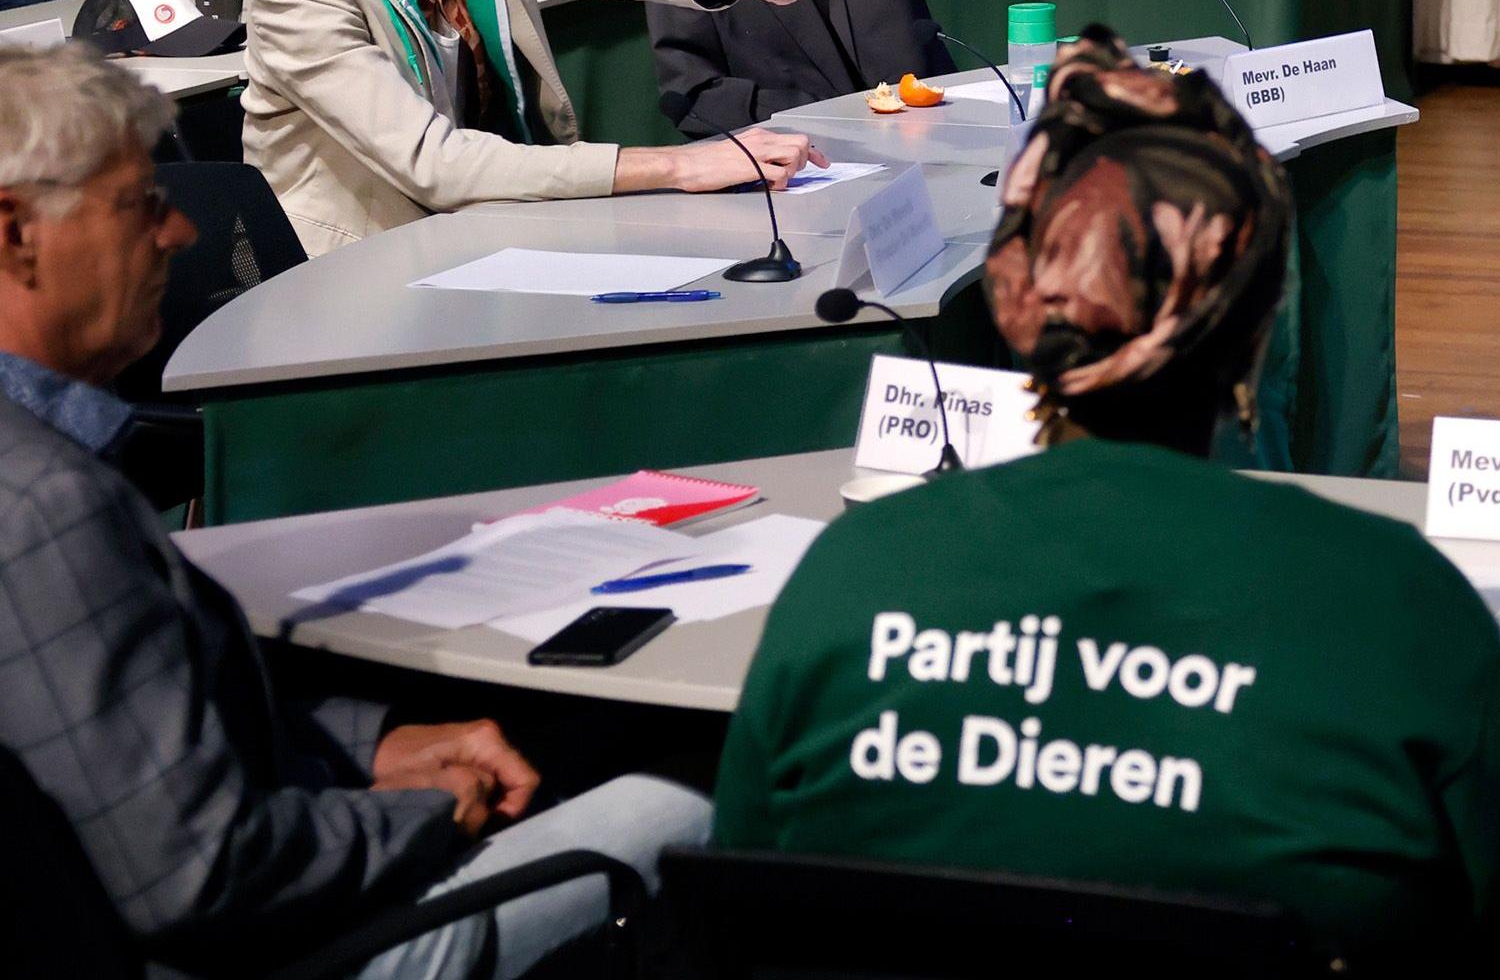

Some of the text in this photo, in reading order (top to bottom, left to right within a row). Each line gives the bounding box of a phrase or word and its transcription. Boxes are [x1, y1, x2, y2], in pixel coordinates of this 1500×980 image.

[1242, 58, 1337, 86] Mevr. De Haan
[1246, 86, 1285, 110] (BBB)
[884, 384, 925, 408] Dhr.
[879, 415, 938, 445] (PRO)
[868, 611, 1256, 714] Partij voor
[849, 710, 1203, 812] de Dieren
